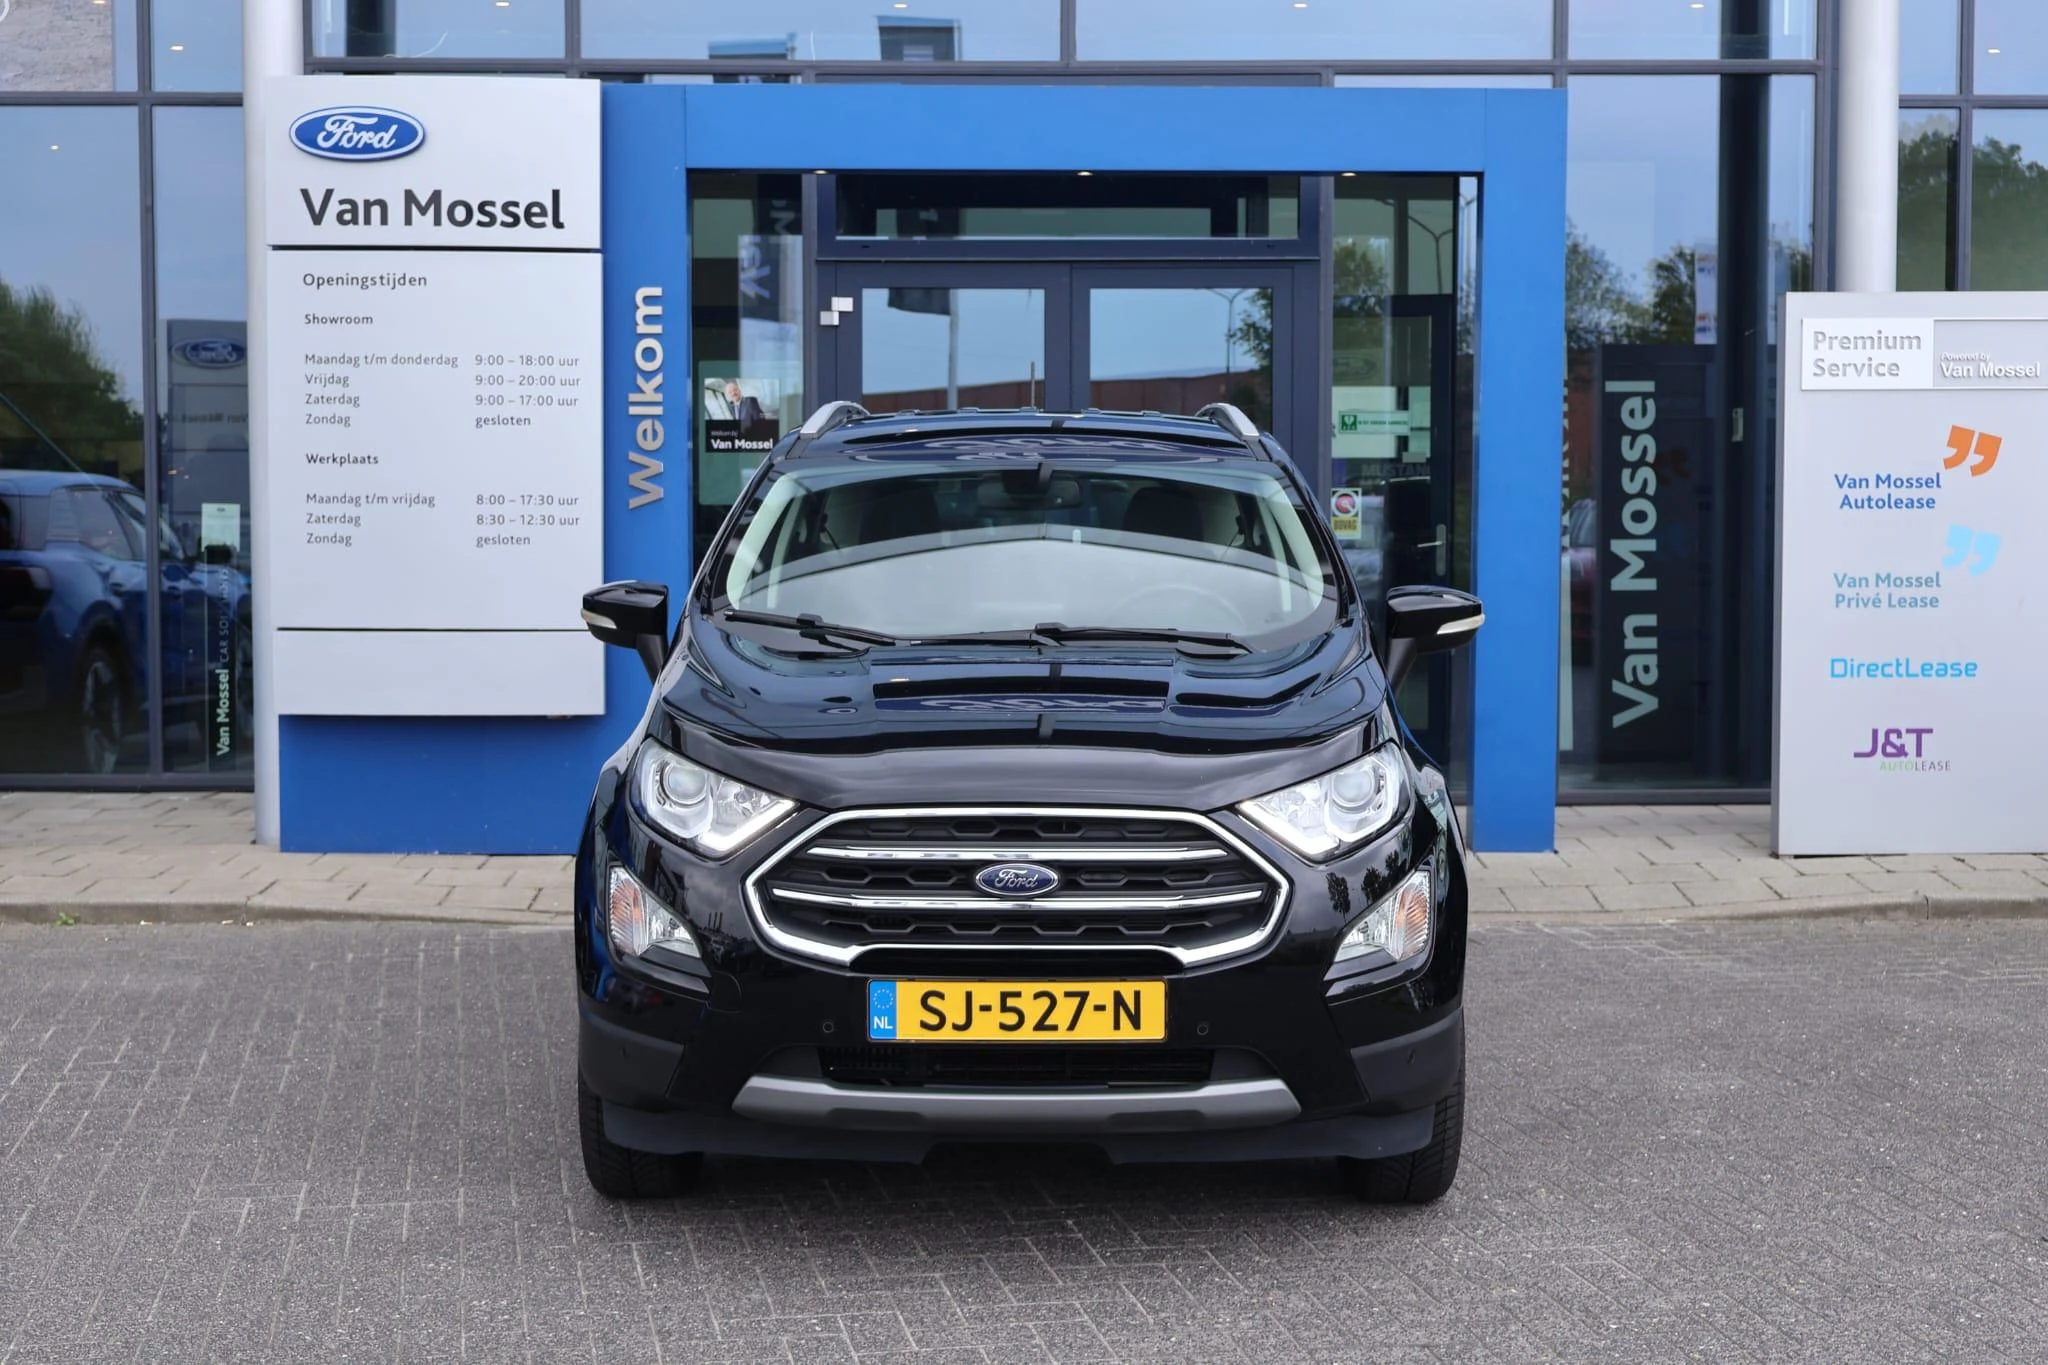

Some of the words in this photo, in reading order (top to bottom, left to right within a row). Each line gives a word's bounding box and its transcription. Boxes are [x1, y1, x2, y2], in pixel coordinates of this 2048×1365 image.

[317, 114, 396, 149] Ford
[300, 188, 388, 226] Van
[404, 189, 565, 229] Mossel
[303, 273, 426, 290] Openingstijden
[305, 313, 373, 324] Showroom
[1813, 331, 1921, 350] Premium
[305, 353, 360, 368] Maandag
[364, 353, 387, 365] t/m
[391, 353, 458, 368] donderdag
[475, 354, 504, 366] 9:00
[520, 355, 554, 366] 18:00
[559, 358, 579, 366] uur
[1813, 357, 1900, 377] Service
[1940, 362, 1973, 378] Van
[1978, 361, 2041, 378] Mossel
[305, 373, 349, 388] Vrijdag
[475, 375, 504, 385] 9:00
[519, 375, 555, 386] 20:00
[560, 378, 580, 386] uur
[306, 393, 360, 408] Zaterdag
[476, 395, 504, 406] 9:00
[520, 395, 553, 406] 17:00
[558, 398, 578, 406] uur
[628, 286, 664, 509] Welkom
[306, 413, 351, 428] Zondag
[476, 414, 530, 428] gesloten
[711, 438, 732, 449] Van
[734, 437, 773, 449] Mossel
[306, 453, 378, 467] Werkplaats
[1605, 380, 1658, 592] Mossel
[1834, 474, 1869, 489] Van
[1876, 472, 1941, 488] Mossel
[306, 492, 361, 507] Maandag
[365, 493, 388, 504] t/m
[392, 493, 435, 508] vrijdag
[476, 494, 505, 505] 8:00
[520, 495, 553, 506] 17:30
[1840, 493, 1936, 509] Autolease
[307, 513, 361, 527] Zaterdag
[477, 514, 505, 525] 8:30
[520, 514, 555, 525] 12:30
[559, 518, 580, 526] uur
[307, 532, 352, 547] Zondag
[476, 534, 530, 548] gesloten
[1833, 573, 1869, 588] Van
[1875, 571, 1941, 588] Mossel
[1836, 592, 1882, 608] Privé
[1888, 592, 1939, 608] Lease
[1612, 613, 1659, 728] Van
[1831, 657, 1978, 678] DirectLease
[215, 668, 230, 723] Mossel
[216, 726, 230, 756] Van
[1854, 728, 1933, 758] J&T
[1880, 761, 1951, 772] AUTOLEASE
[994, 868, 1039, 888] Ford
[919, 989, 1141, 1032] SJ-527-N
[873, 1016, 893, 1029] NL
